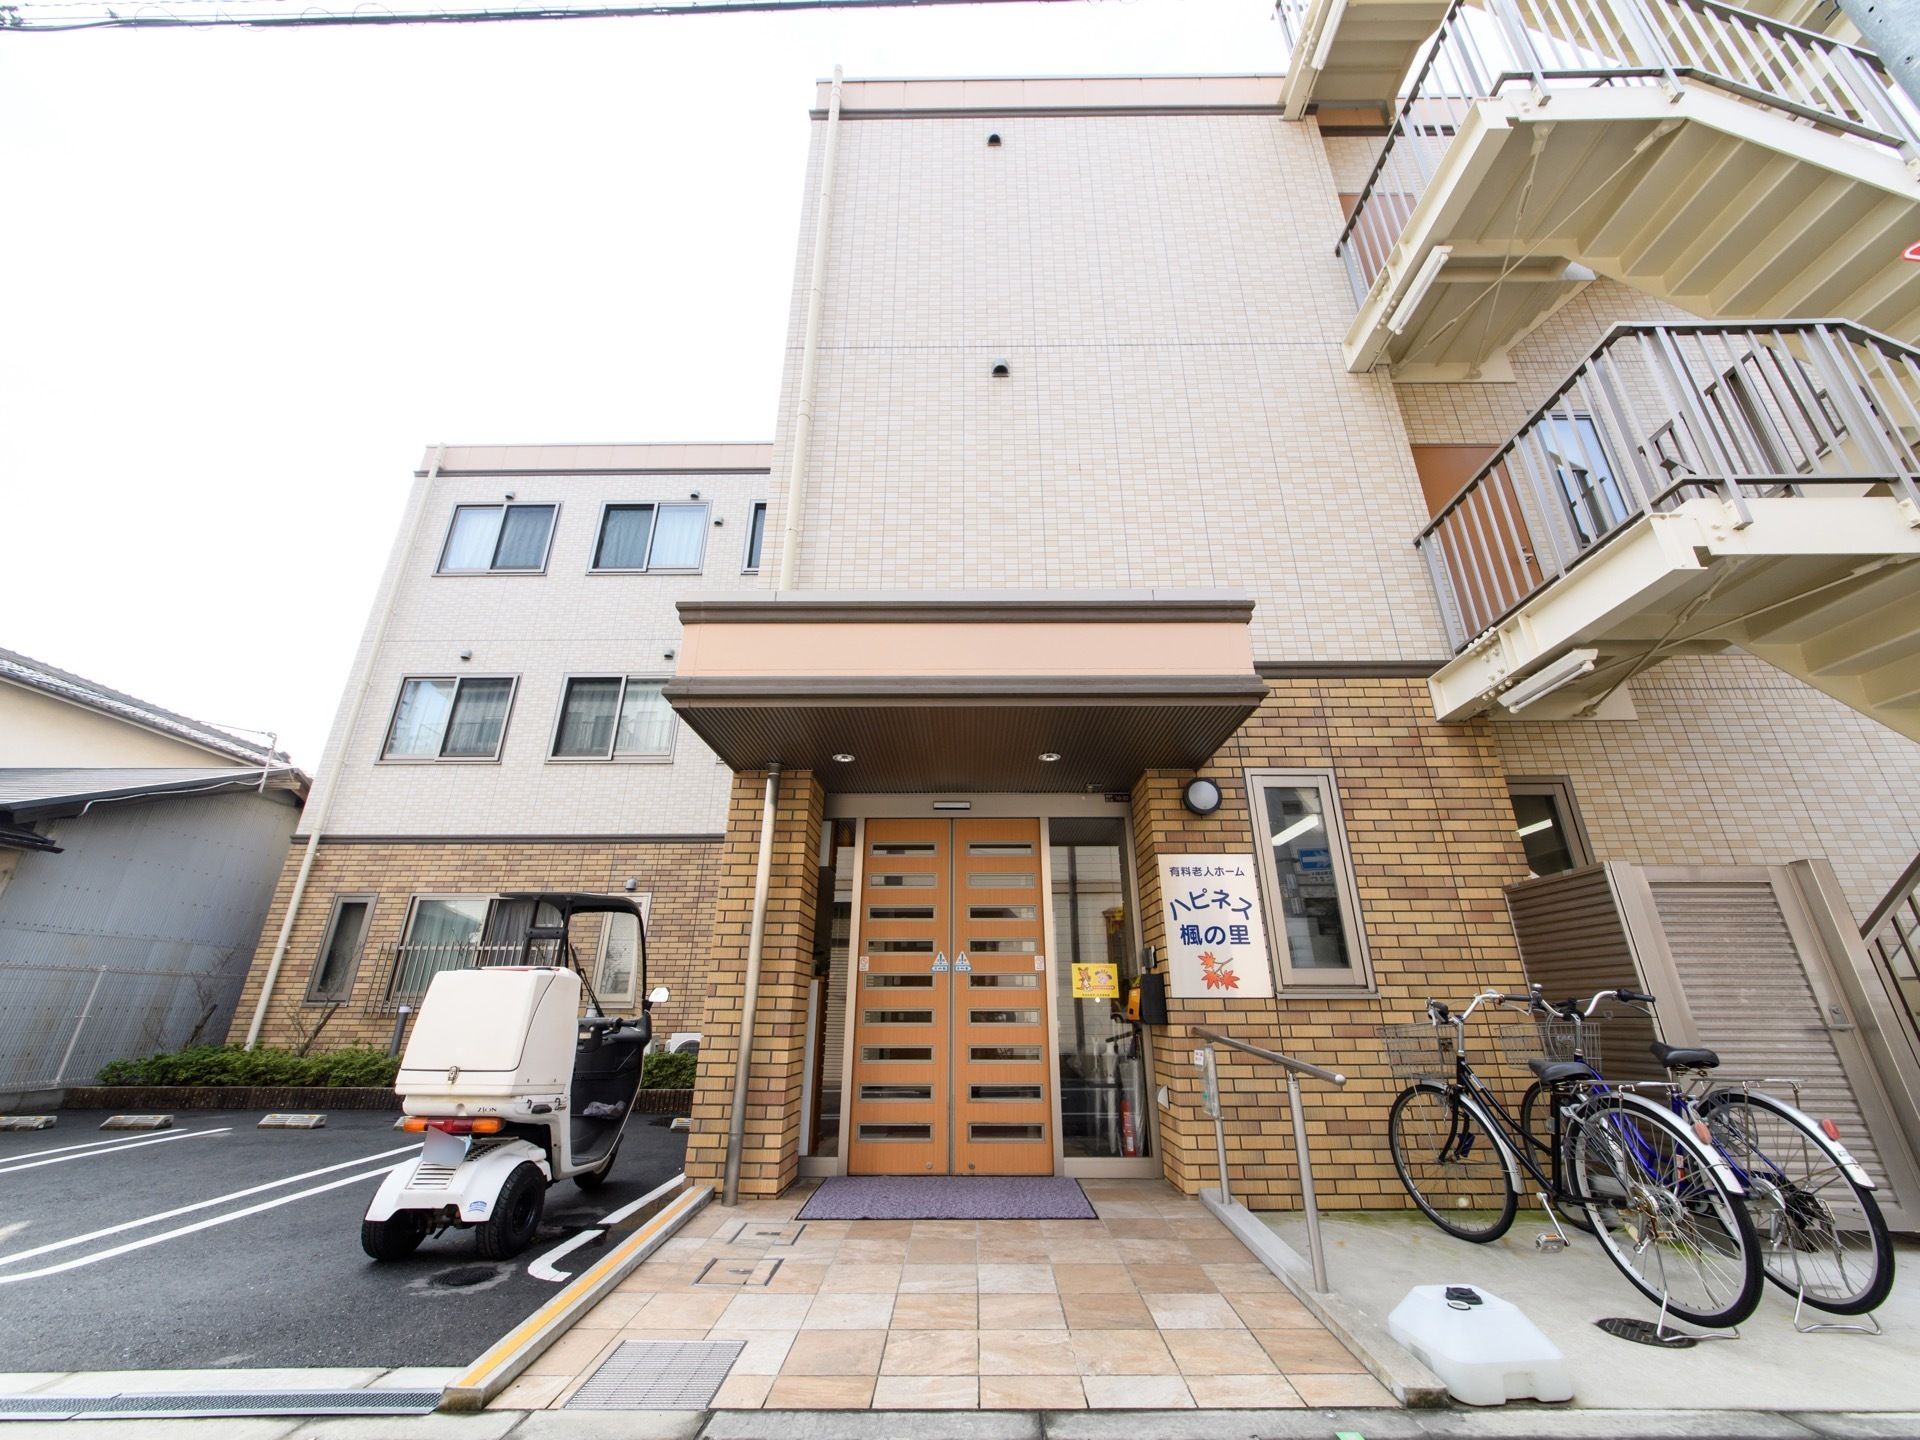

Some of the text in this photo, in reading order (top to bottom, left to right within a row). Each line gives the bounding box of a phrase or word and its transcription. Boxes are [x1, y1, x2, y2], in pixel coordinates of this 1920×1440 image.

[1169, 866, 1245, 877] 有料老人ホーム
[1169, 887, 1253, 921] ハピネス
[1179, 924, 1251, 946] 楓の里
